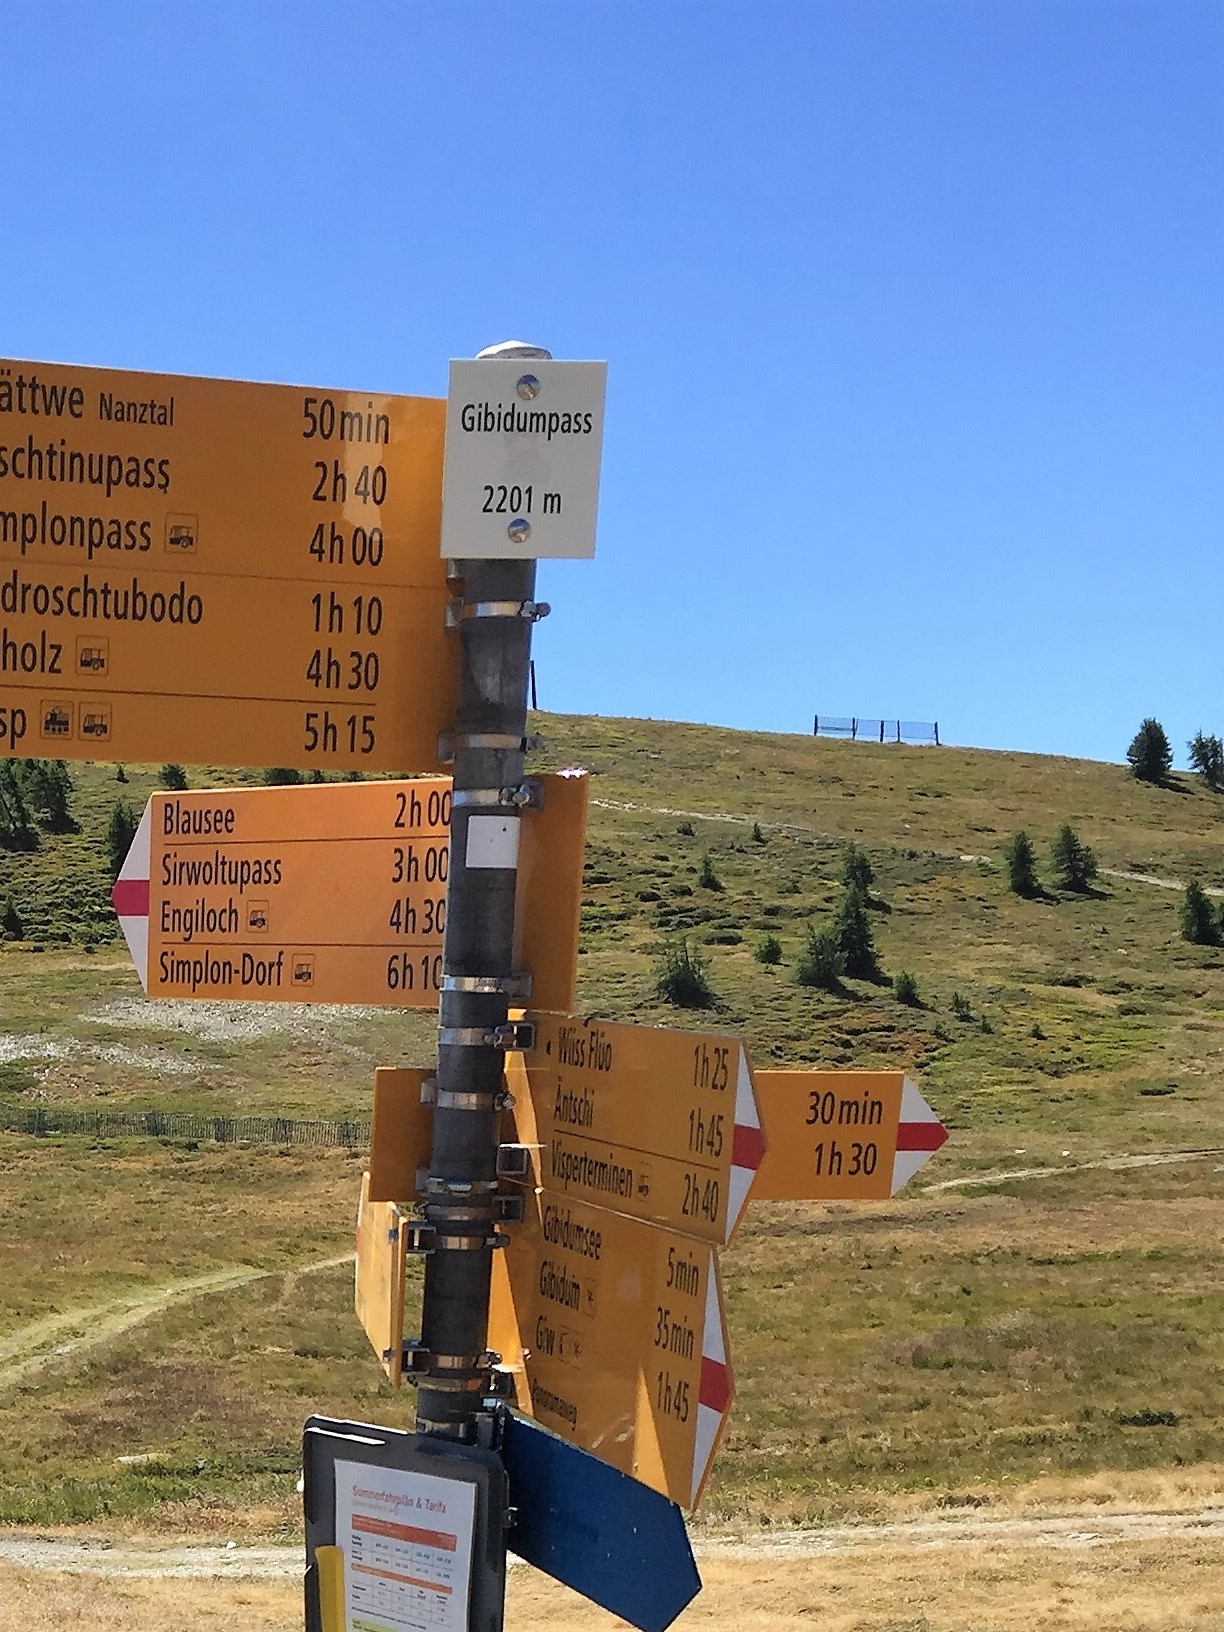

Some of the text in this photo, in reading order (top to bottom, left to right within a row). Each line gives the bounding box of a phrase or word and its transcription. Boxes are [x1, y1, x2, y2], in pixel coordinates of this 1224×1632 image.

[99, 392, 175, 428] Nanztal
[461, 402, 593, 441] Gibidumpass
[482, 484, 562, 515] 2201 m
[163, 802, 235, 835] Blausee
[162, 851, 282, 894] Sirwoltupass
[161, 899, 239, 941] Engiloch
[159, 952, 284, 992] Simplon-Dorf
[552, 1140, 633, 1198] Visperterminen
